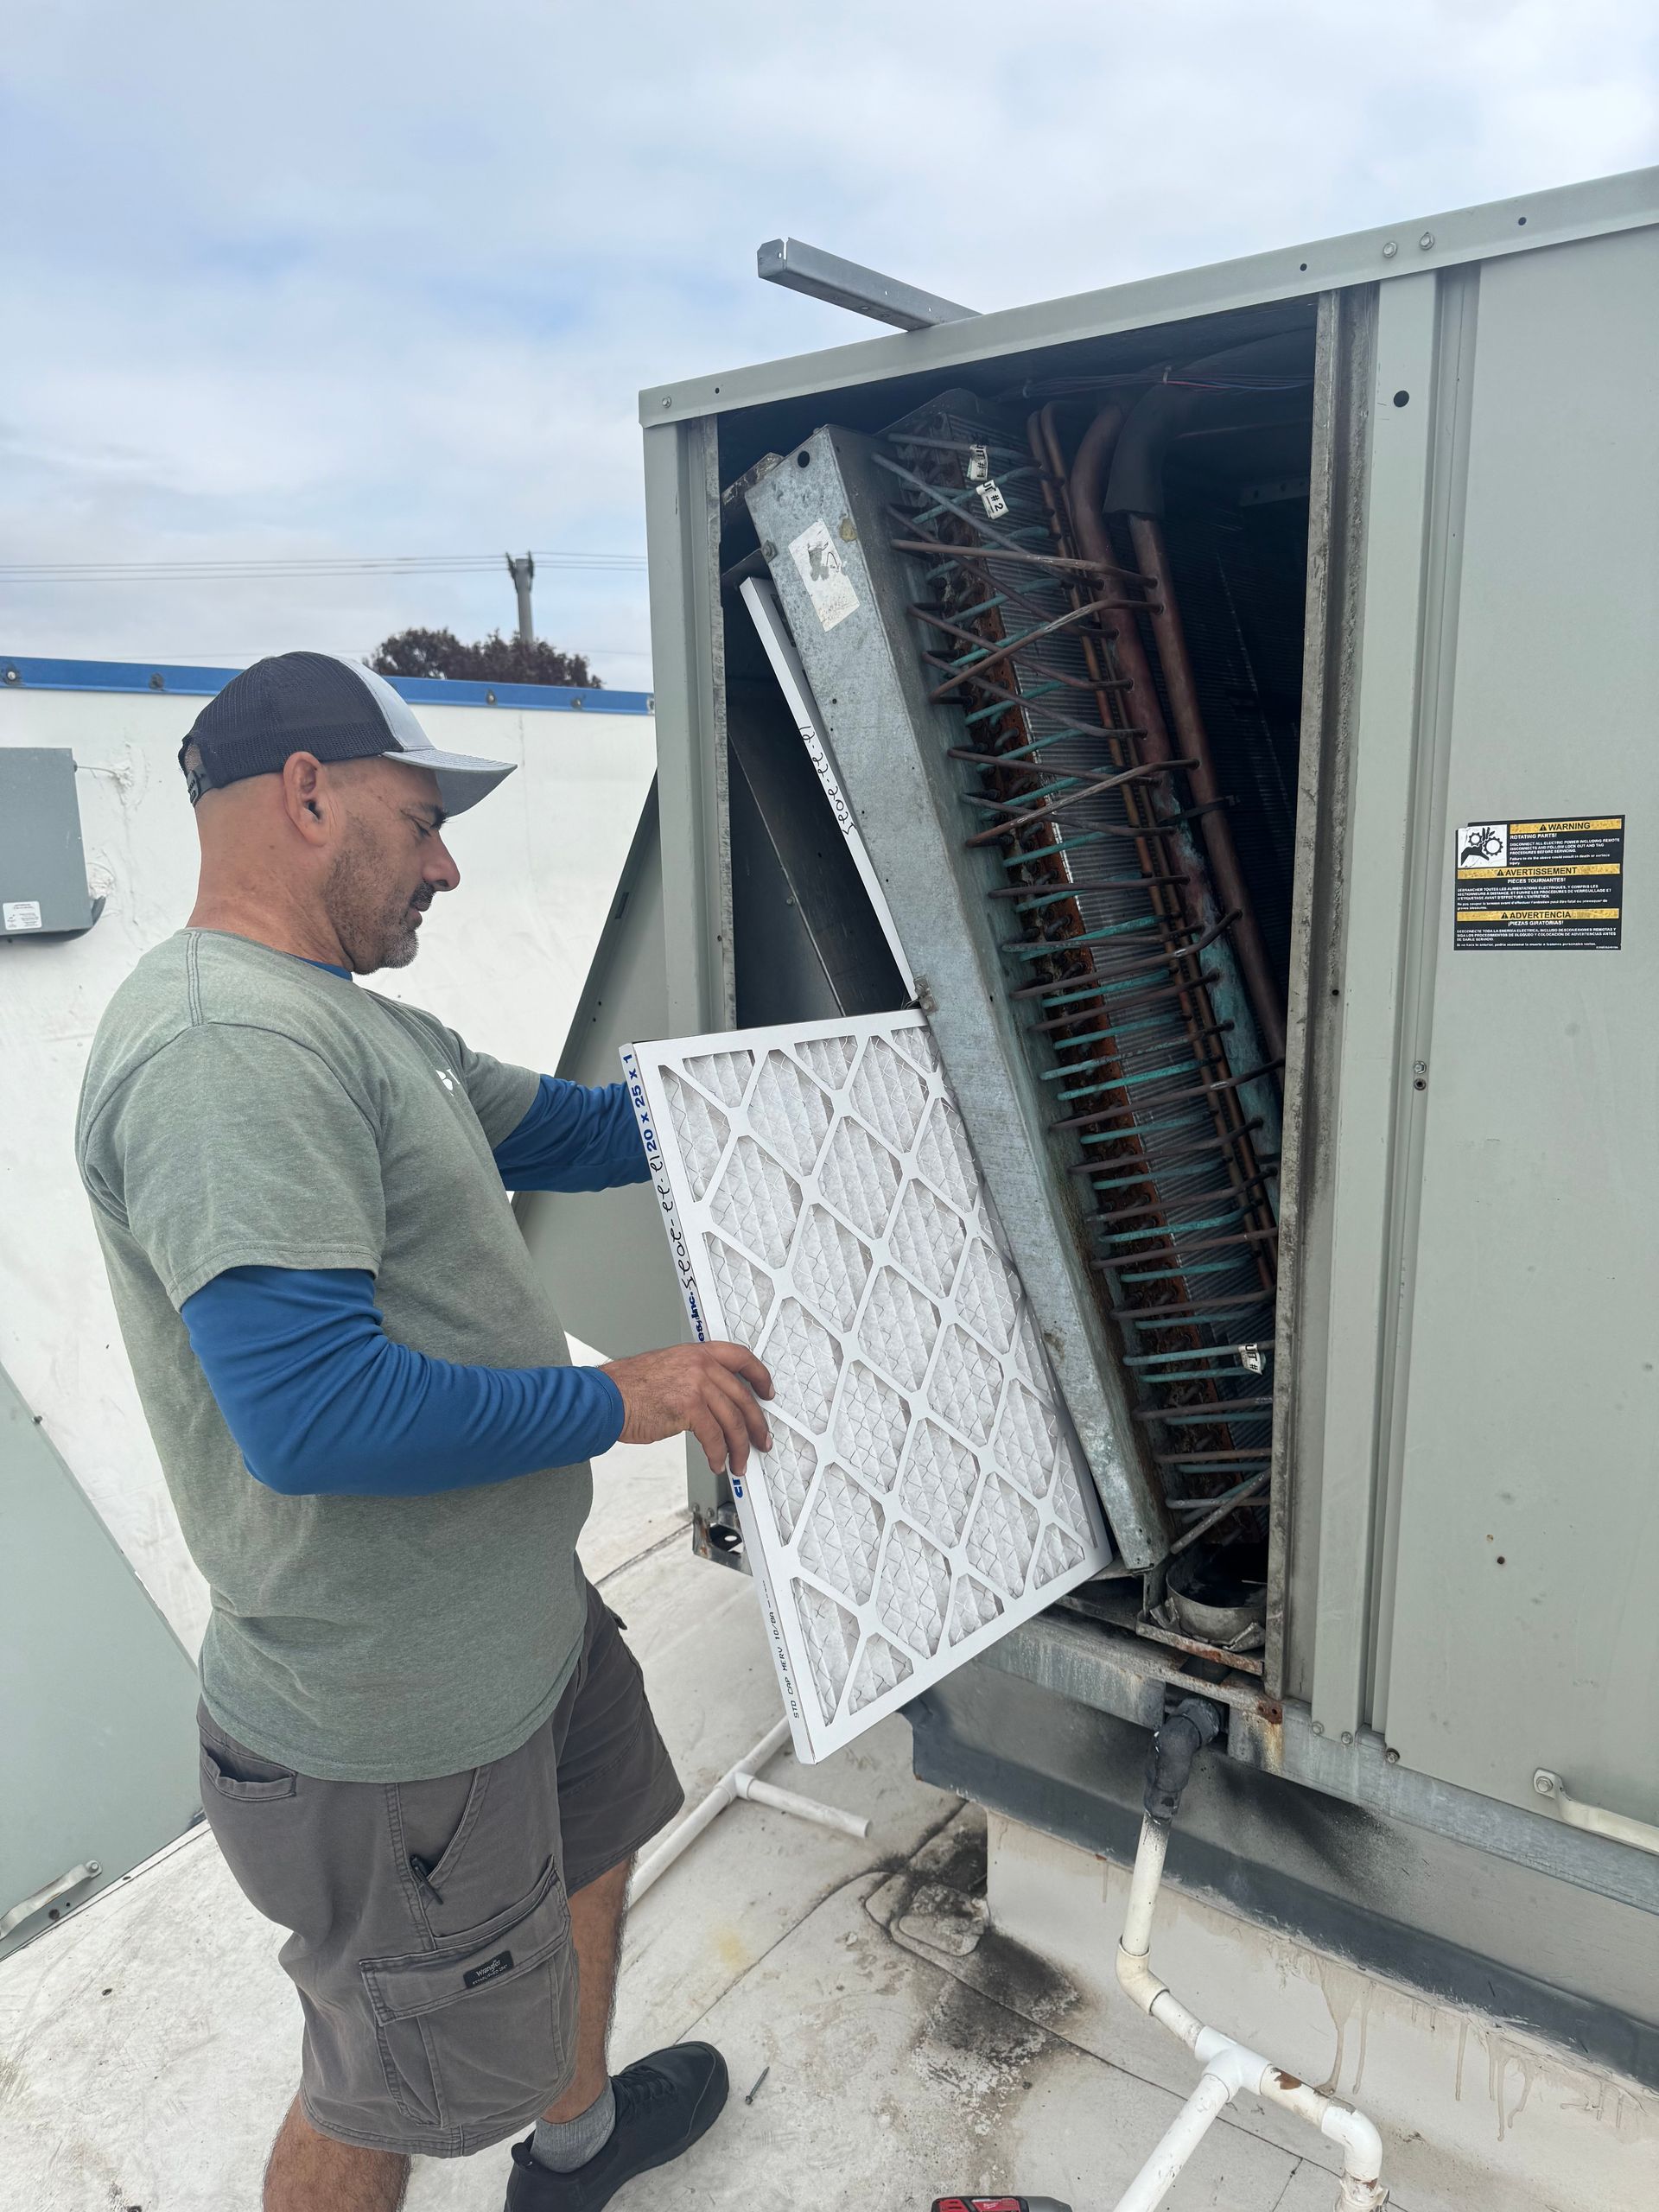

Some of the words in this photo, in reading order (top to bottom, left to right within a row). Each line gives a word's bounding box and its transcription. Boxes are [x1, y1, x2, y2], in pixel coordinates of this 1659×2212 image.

[1505, 867, 1577, 875] AVERTISSEMENT
[623, 1054, 632, 1064] 1
[629, 1068, 638, 1080] x
[632, 1085, 645, 1108] 25
[640, 1112, 650, 1123] x
[644, 1129, 657, 1152] 20
[778, 1647, 787, 1671] MERV
[785, 1677, 793, 1694] CAP
[791, 1700, 799, 1719] STD
[476, 1960, 500, 1976] Wrangler
